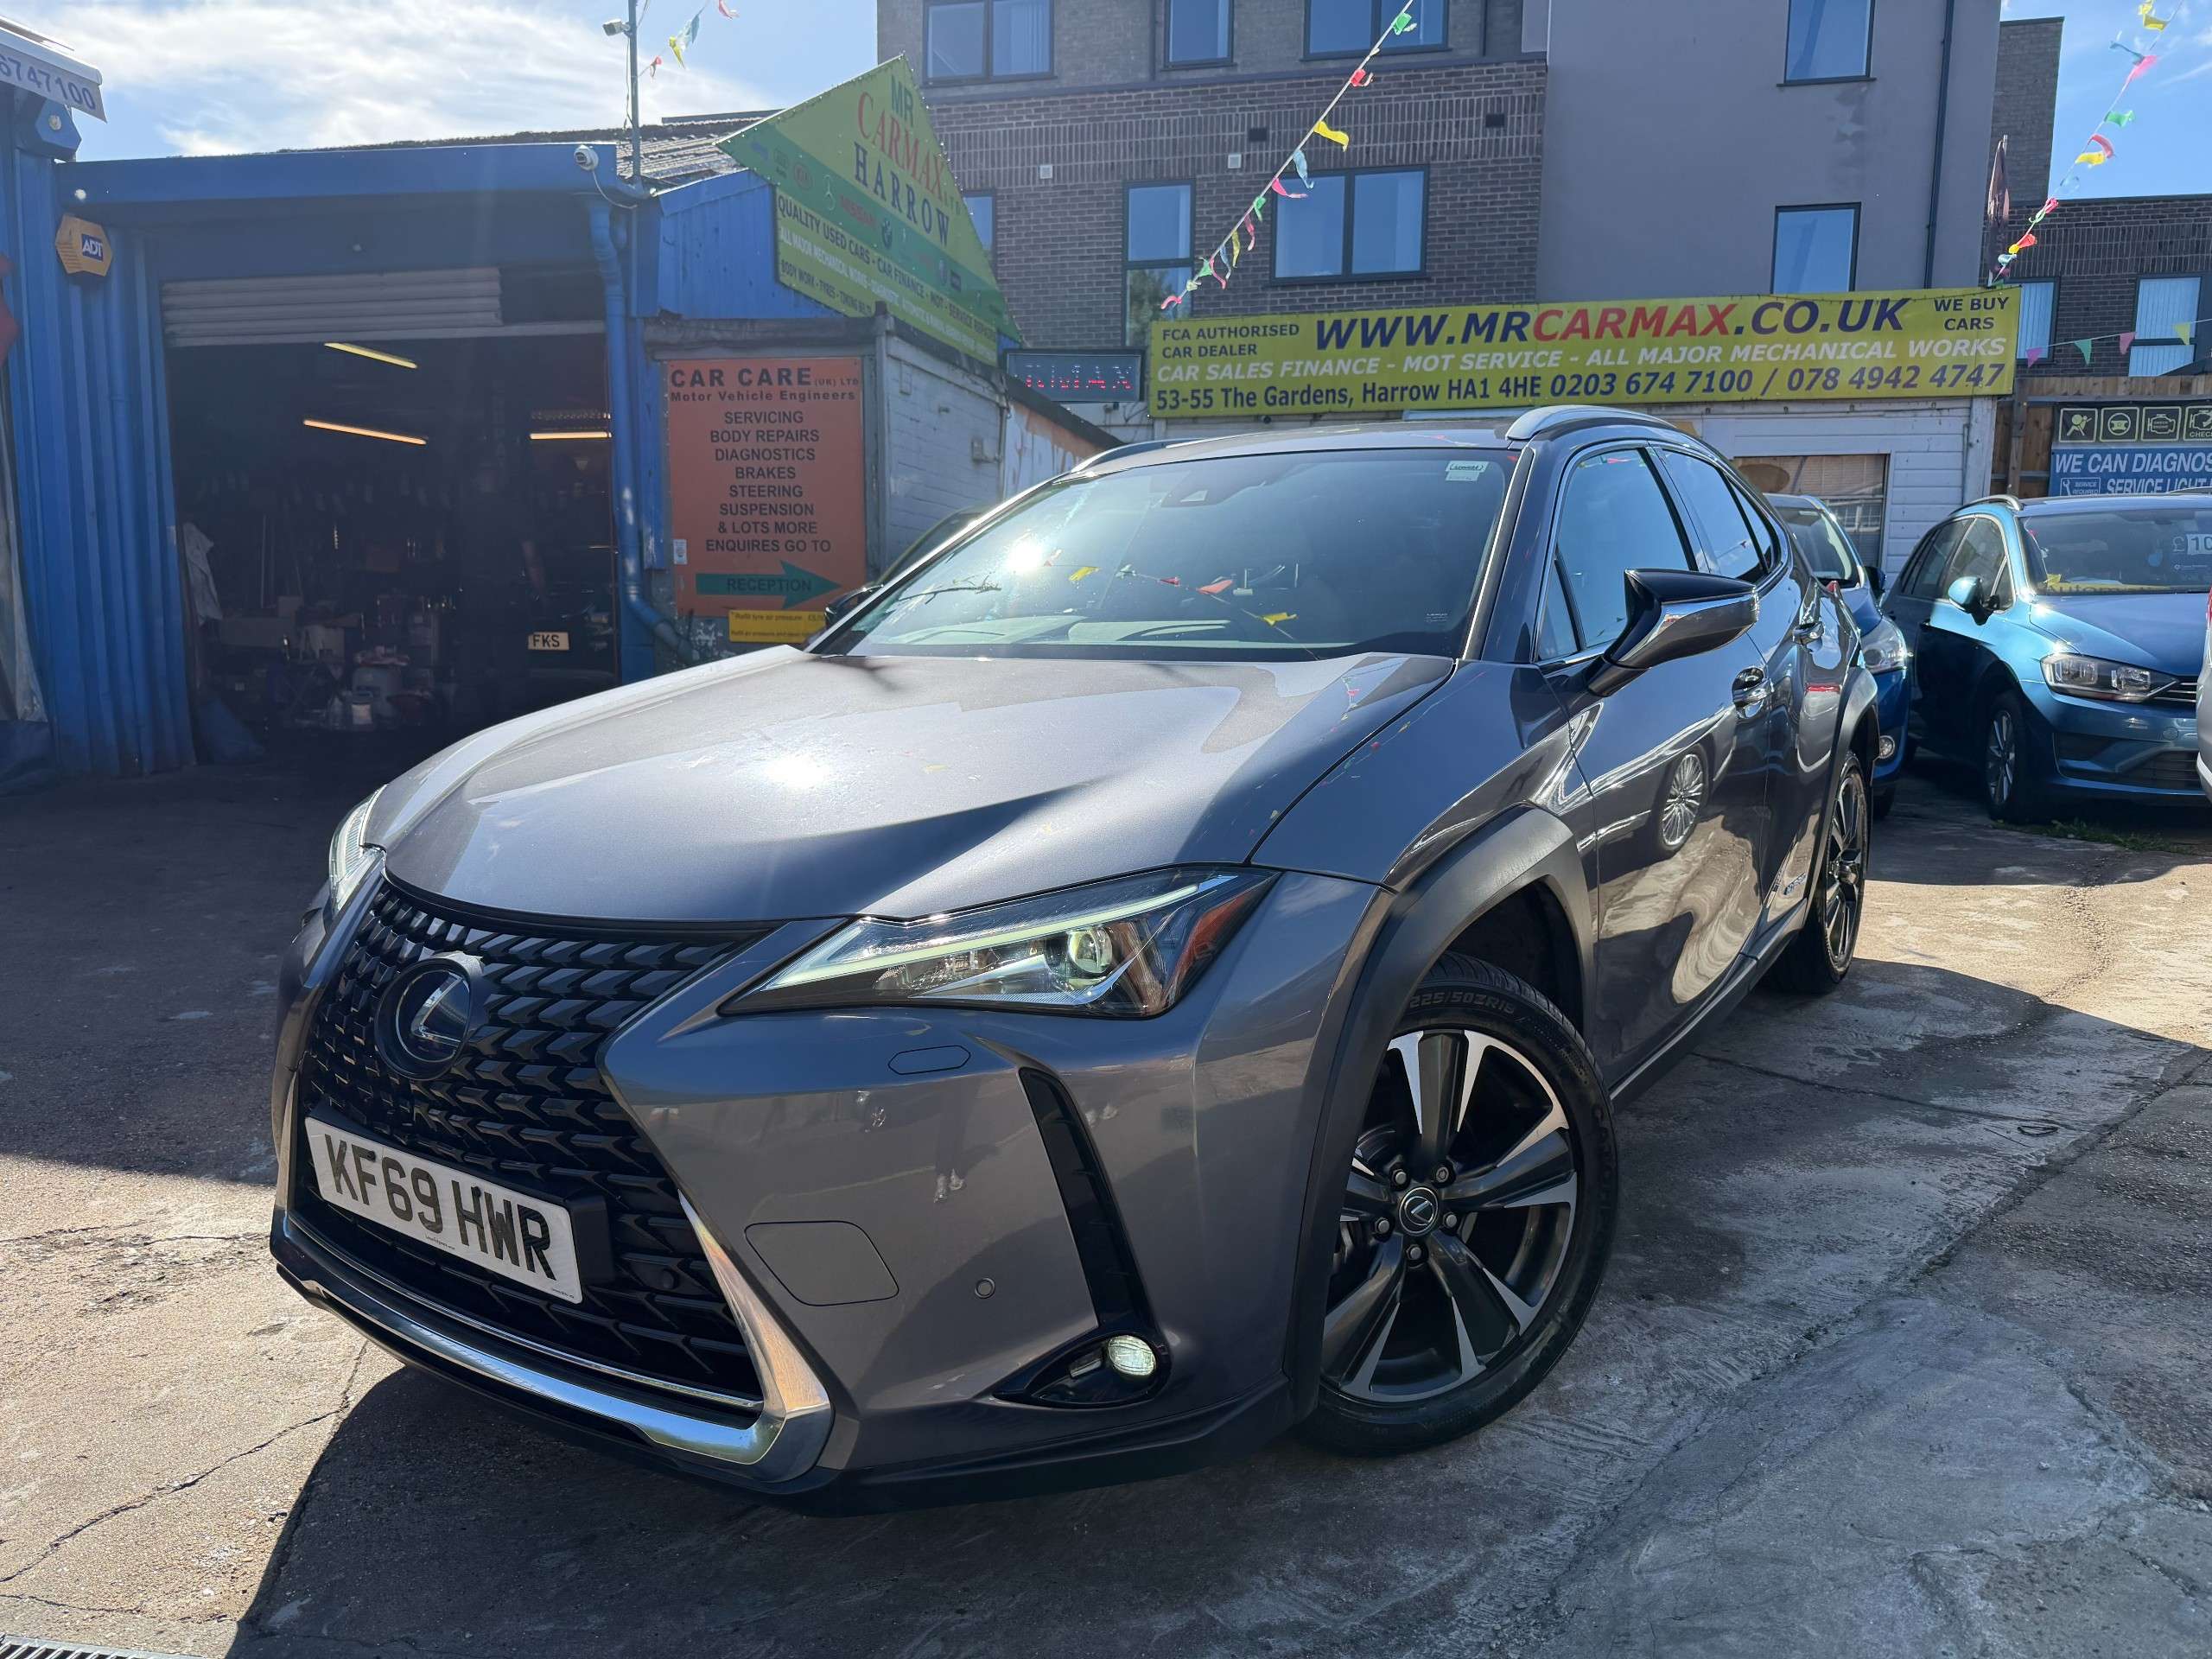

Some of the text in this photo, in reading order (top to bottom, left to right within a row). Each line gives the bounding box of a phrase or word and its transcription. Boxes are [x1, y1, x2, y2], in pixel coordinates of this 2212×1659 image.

[892, 74, 913, 127] MR
[858, 92, 945, 203] CARMAX
[855, 142, 949, 246] HARROW
[82, 238, 103, 257] ADT
[779, 195, 821, 233] QUALITY
[823, 222, 847, 250] USED
[849, 239, 870, 264] CARS
[878, 257, 892, 276] CAR
[893, 270, 925, 299] FINANCE
[1935, 296, 2009, 312] WE BUY
[1316, 298, 1911, 351] WWW.MRCARMAX.CO.UK
[1943, 317, 1994, 331] CARS
[1162, 324, 1300, 341] FCA AUTHORISED
[1162, 344, 1257, 359] CAR DEALER
[1157, 365, 1199, 382] CAR
[1205, 361, 1274, 381] SALES
[1280, 358, 1381, 378] FINANCE
[1403, 353, 1455, 373] MOT
[1459, 351, 1563, 371] SERVICE
[1586, 349, 1630, 365] ALL
[1637, 345, 1723, 365] MAJOR
[1730, 340, 1897, 363] MECHANICAL
[1908, 338, 2006, 358] WORKS
[671, 369, 725, 388] CAR
[738, 367, 812, 386] CARE
[1157, 363, 2005, 410] 53-55 The Gardens, Harrow HA1 4HE 0203 674 7100 / 078 4942 4747
[671, 390, 855, 403] Motor Vehicle Engineers
[724, 410, 804, 424] SERVICING
[710, 429, 819, 443] BODY REPAIRS
[715, 448, 816, 461] DIAGNOSTICS
[2056, 454, 2083, 474] WE
[2088, 453, 2129, 474] CAN
[735, 467, 796, 480] BRAKES
[729, 485, 803, 498] STEERING
[2107, 478, 2164, 494] SERVICE
[719, 503, 814, 516] SUSPENSION
[718, 521, 817, 534] & LOTS MORE
[706, 539, 831, 553] ENQUIRES GO TO
[727, 578, 811, 592] RECEPTION
[533, 634, 560, 648] FKS
[324, 1134, 557, 1281] KF69 HWR
